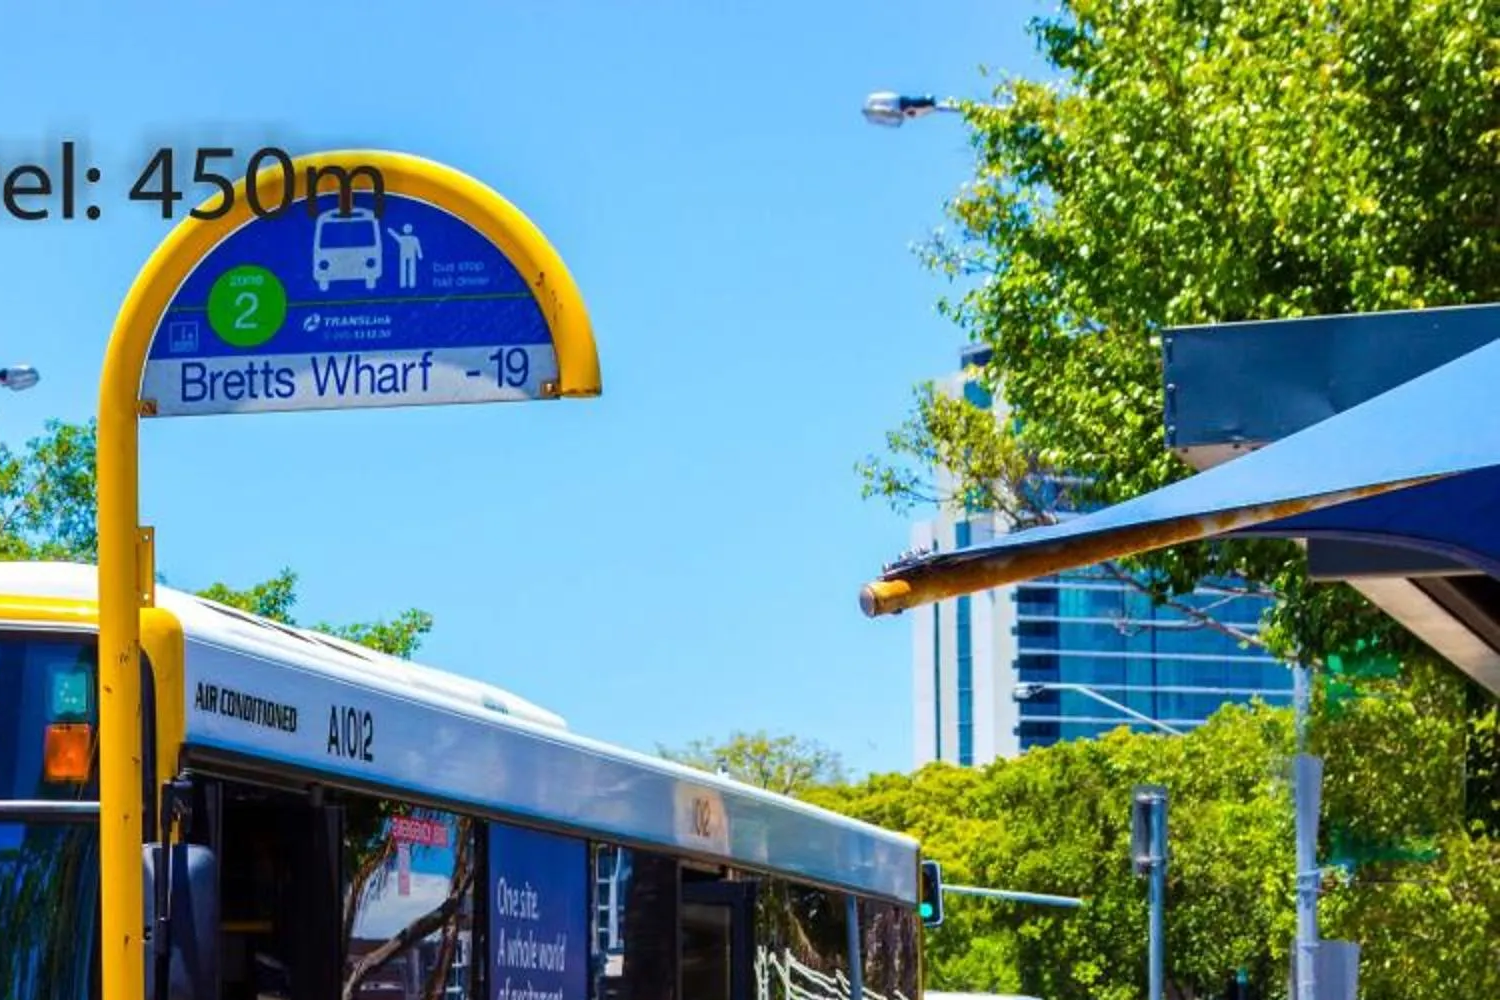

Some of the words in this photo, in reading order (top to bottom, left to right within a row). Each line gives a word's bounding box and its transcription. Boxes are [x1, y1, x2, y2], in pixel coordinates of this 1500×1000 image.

[234, 291, 259, 329] 2
[182, 355, 296, 402] Bretts
[309, 351, 434, 397] Wharf
[195, 681, 218, 714] AIR
[219, 687, 298, 733] CONDITIONED
[497, 877, 519, 919] One
[497, 927, 506, 968] A
[506, 927, 537, 970] whole
[539, 931, 567, 973] world
